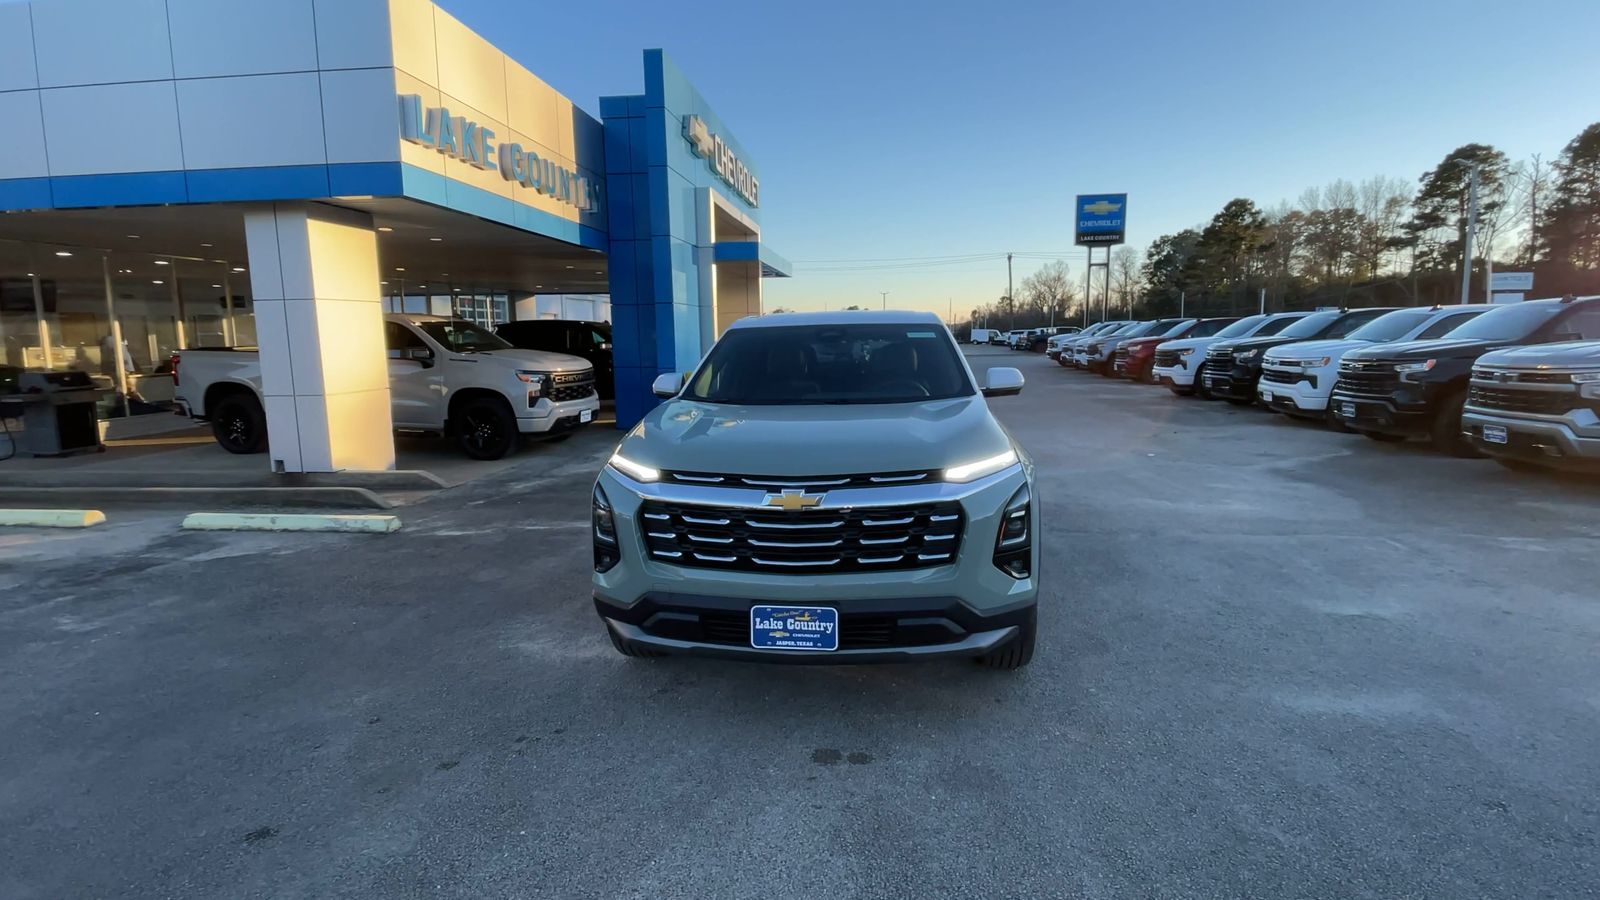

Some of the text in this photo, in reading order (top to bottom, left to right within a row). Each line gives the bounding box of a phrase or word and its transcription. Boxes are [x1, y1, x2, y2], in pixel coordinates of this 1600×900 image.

[397, 93, 497, 170] LAKE
[712, 133, 759, 207] CHEVROLET
[755, 617, 834, 634] Lake Country
